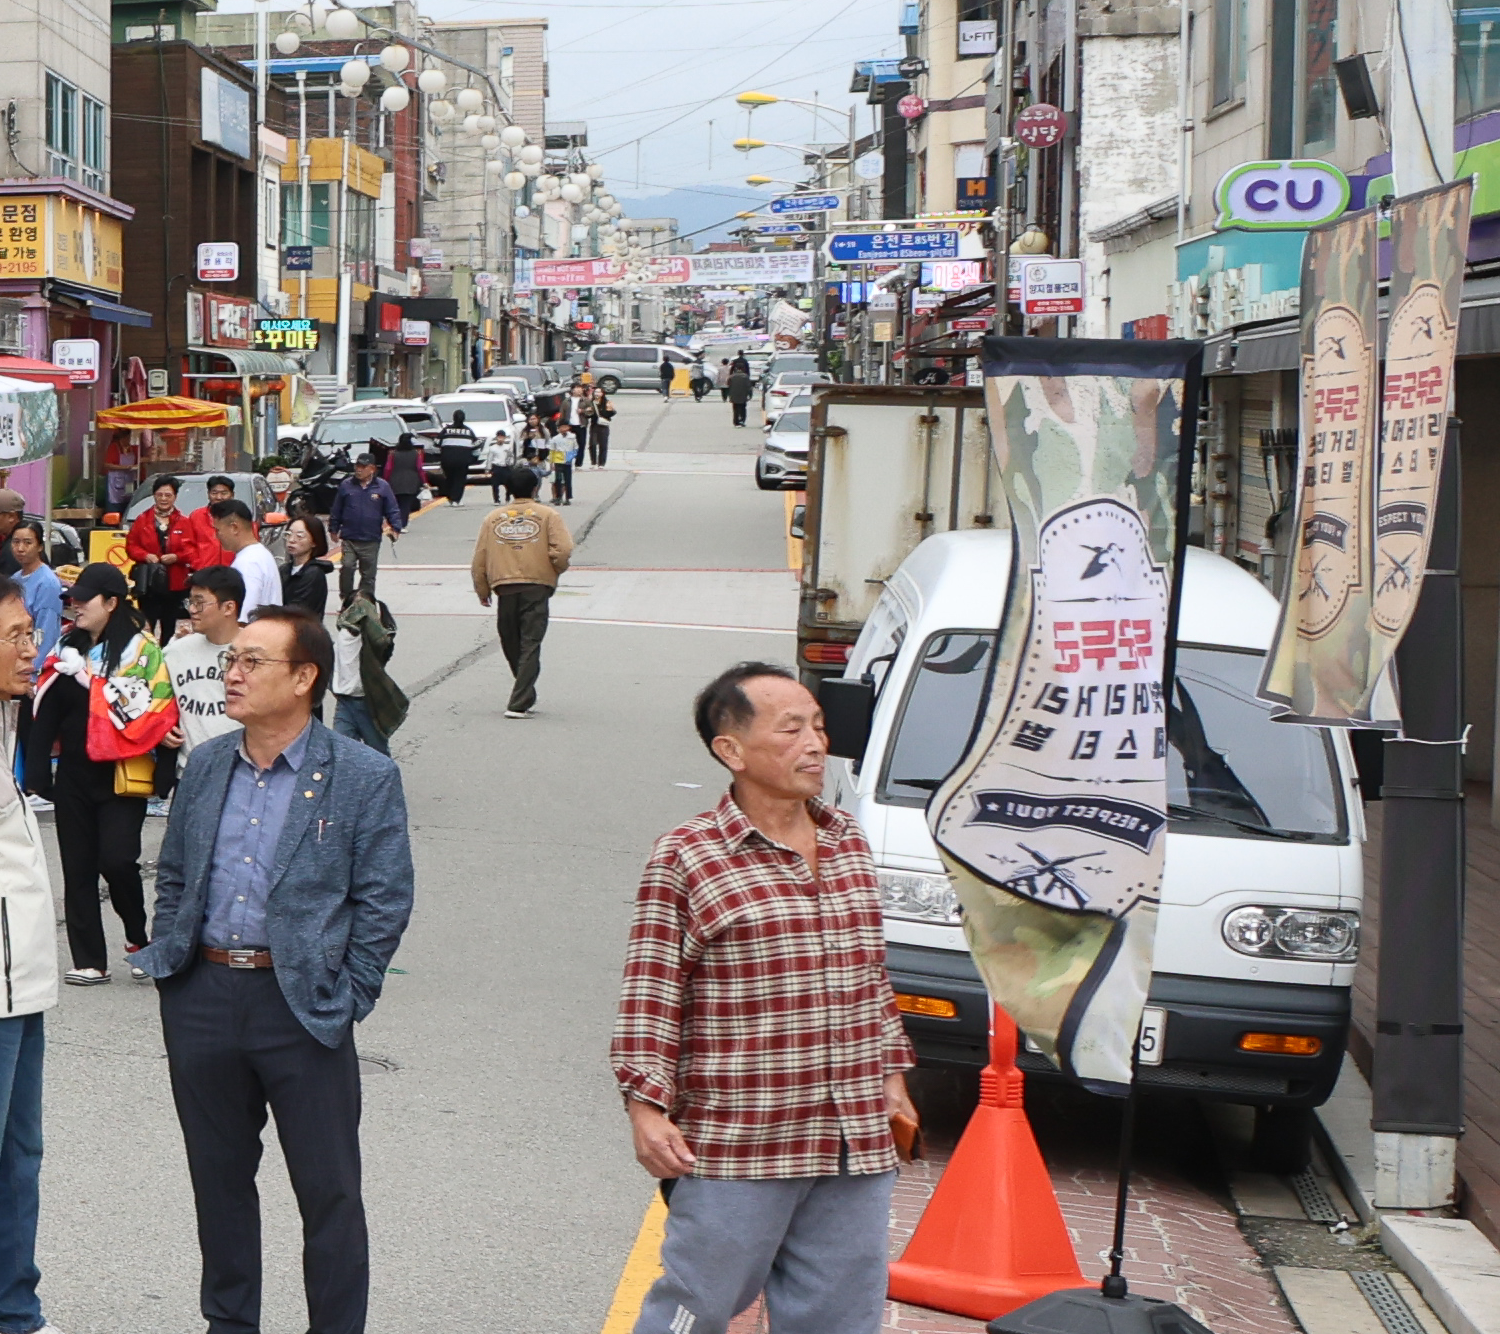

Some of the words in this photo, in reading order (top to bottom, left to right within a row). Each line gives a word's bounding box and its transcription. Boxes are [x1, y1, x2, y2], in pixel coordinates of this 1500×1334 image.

[1021, 126, 1059, 143] 식당
[1244, 178, 1323, 213] CU
[8, 226, 37, 243] 환영
[870, 232, 956, 249] 은전로85번길
